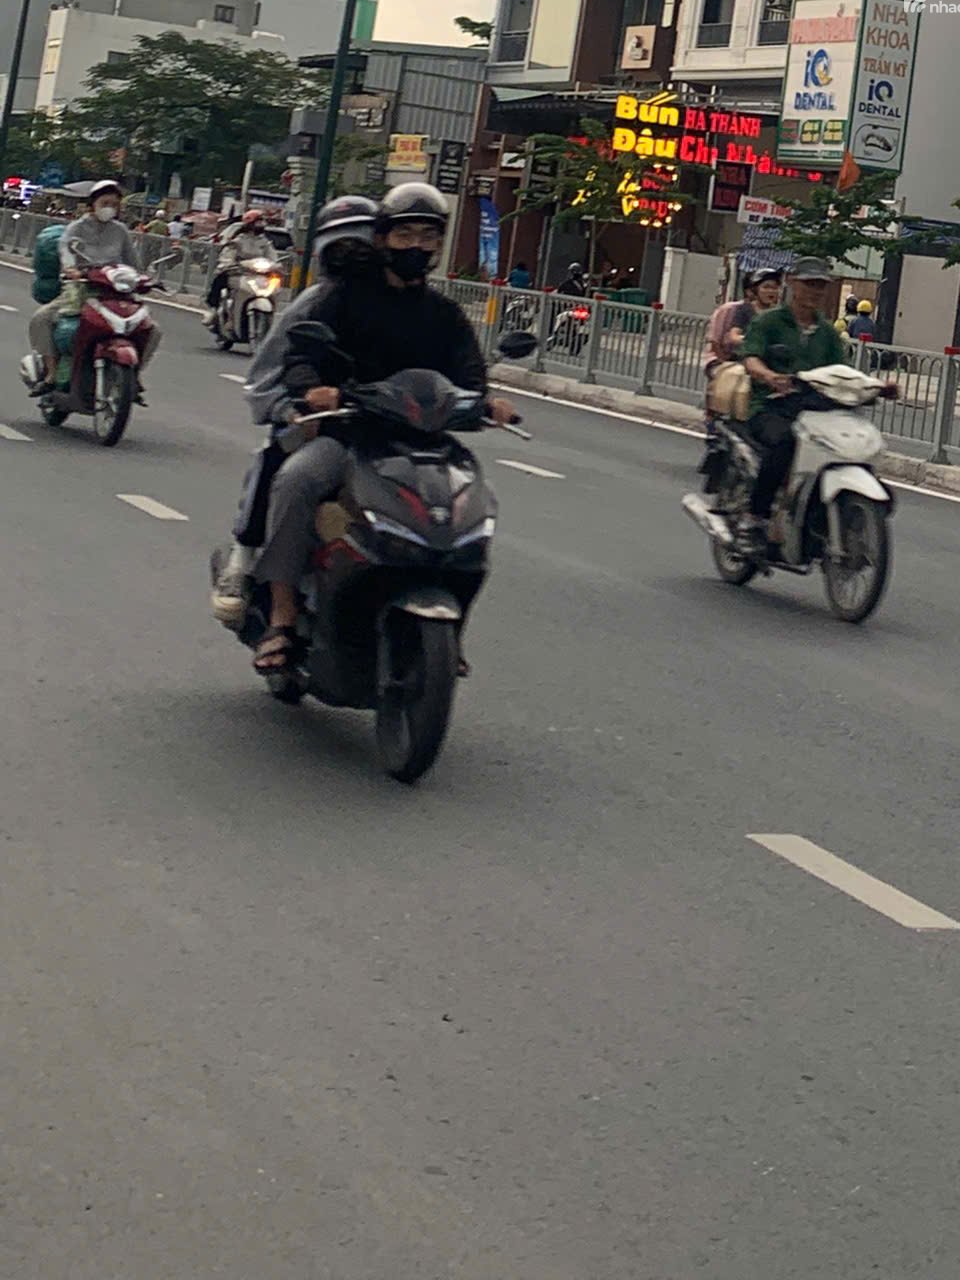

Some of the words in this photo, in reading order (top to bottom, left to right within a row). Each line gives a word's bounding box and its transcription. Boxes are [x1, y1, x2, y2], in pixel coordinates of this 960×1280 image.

[865, 25, 911, 51] KHOA
[615, 90, 679, 127] Bún
[794, 91, 836, 111] DENTAL
[858, 101, 902, 120] DENTAL
[612, 127, 678, 159] Đậu
